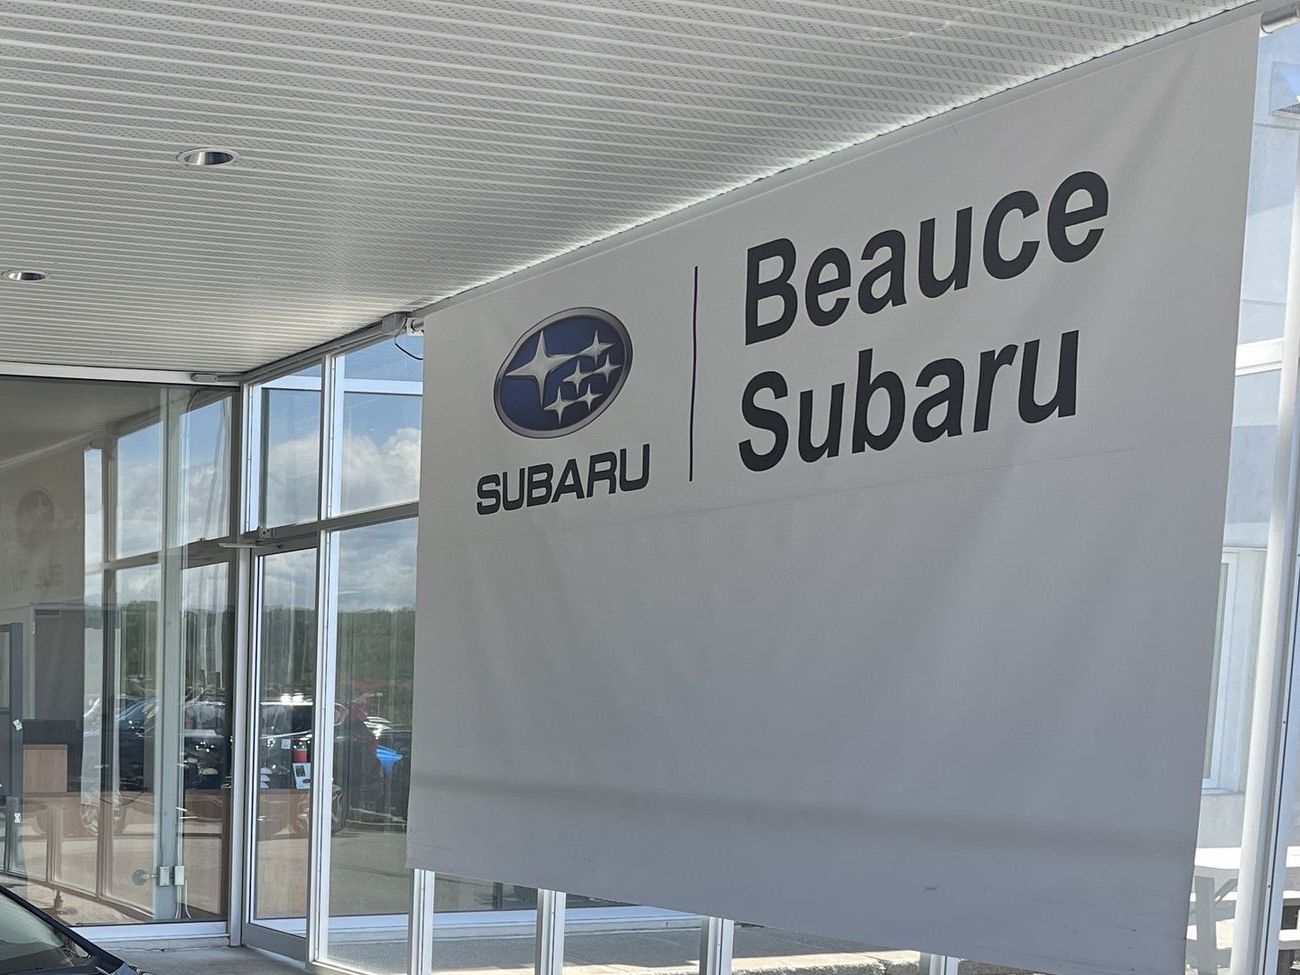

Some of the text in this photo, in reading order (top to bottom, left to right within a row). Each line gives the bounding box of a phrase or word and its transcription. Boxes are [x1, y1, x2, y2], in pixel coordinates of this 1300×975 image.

[744, 170, 1110, 346] Beauce
[738, 329, 1080, 472] Subaru
[476, 443, 651, 516] SUBARU
